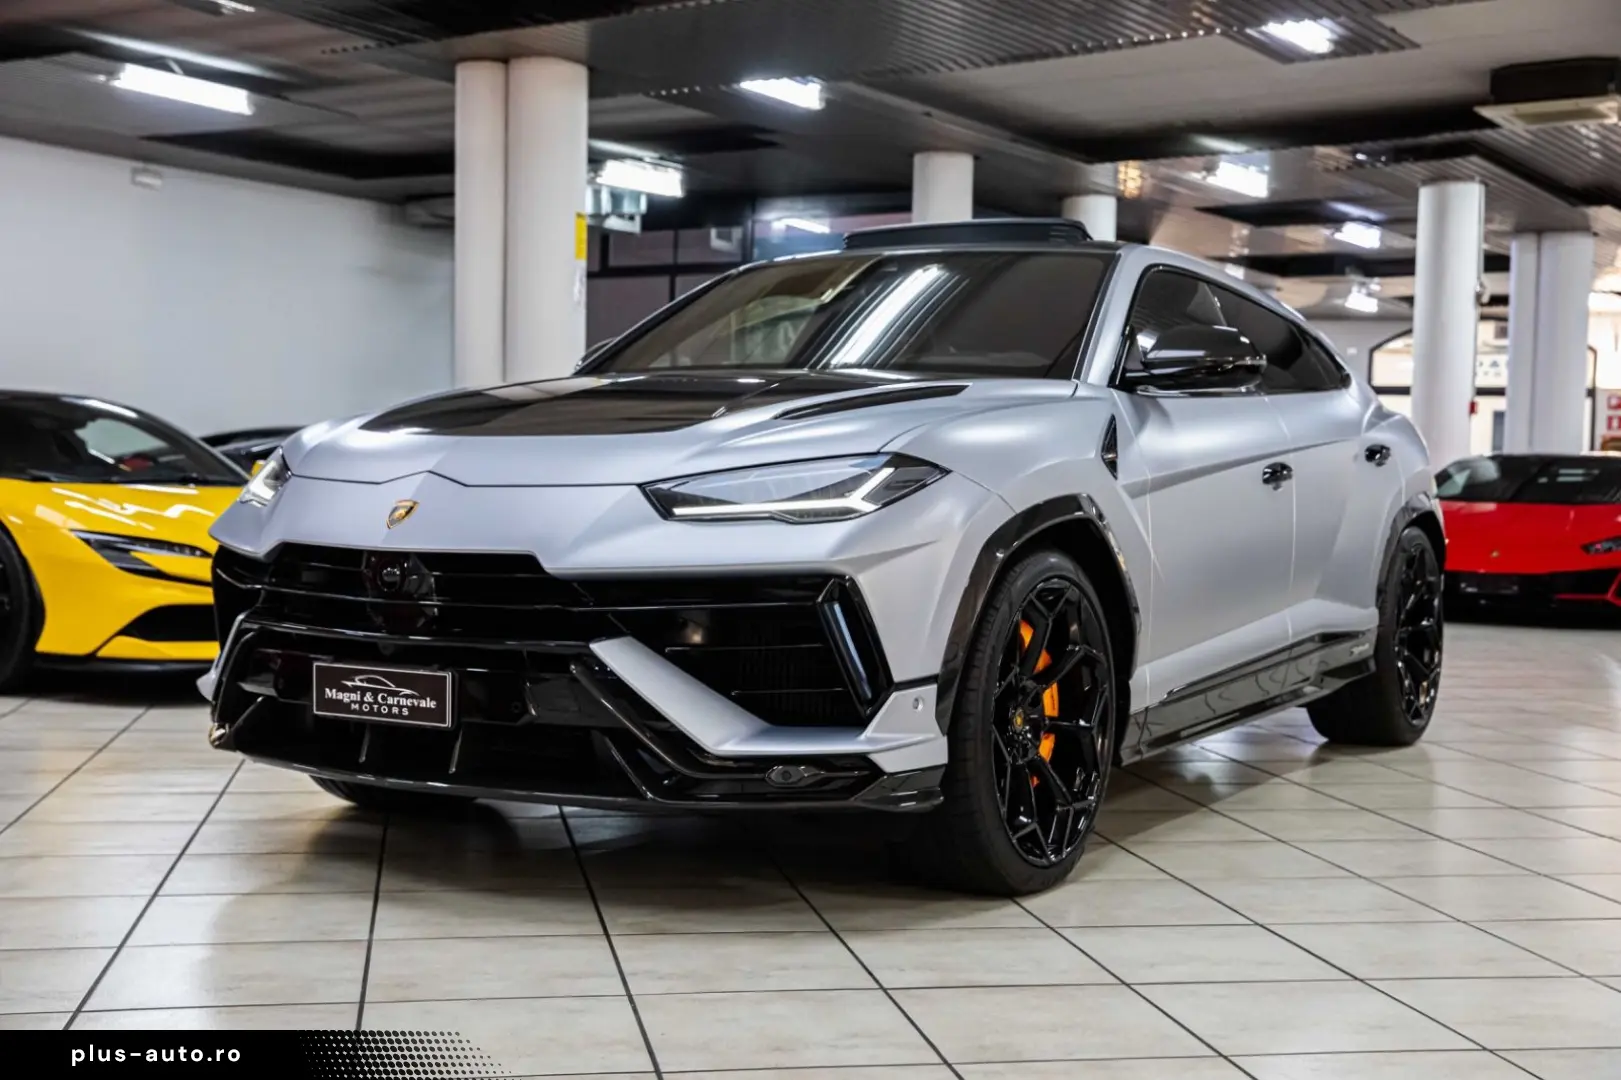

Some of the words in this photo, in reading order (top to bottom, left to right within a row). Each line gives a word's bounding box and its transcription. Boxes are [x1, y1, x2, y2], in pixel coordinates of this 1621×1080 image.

[324, 688, 361, 703] Magni
[363, 691, 374, 703] &
[377, 693, 437, 708] Carnevale
[351, 703, 409, 716] MOTORS
